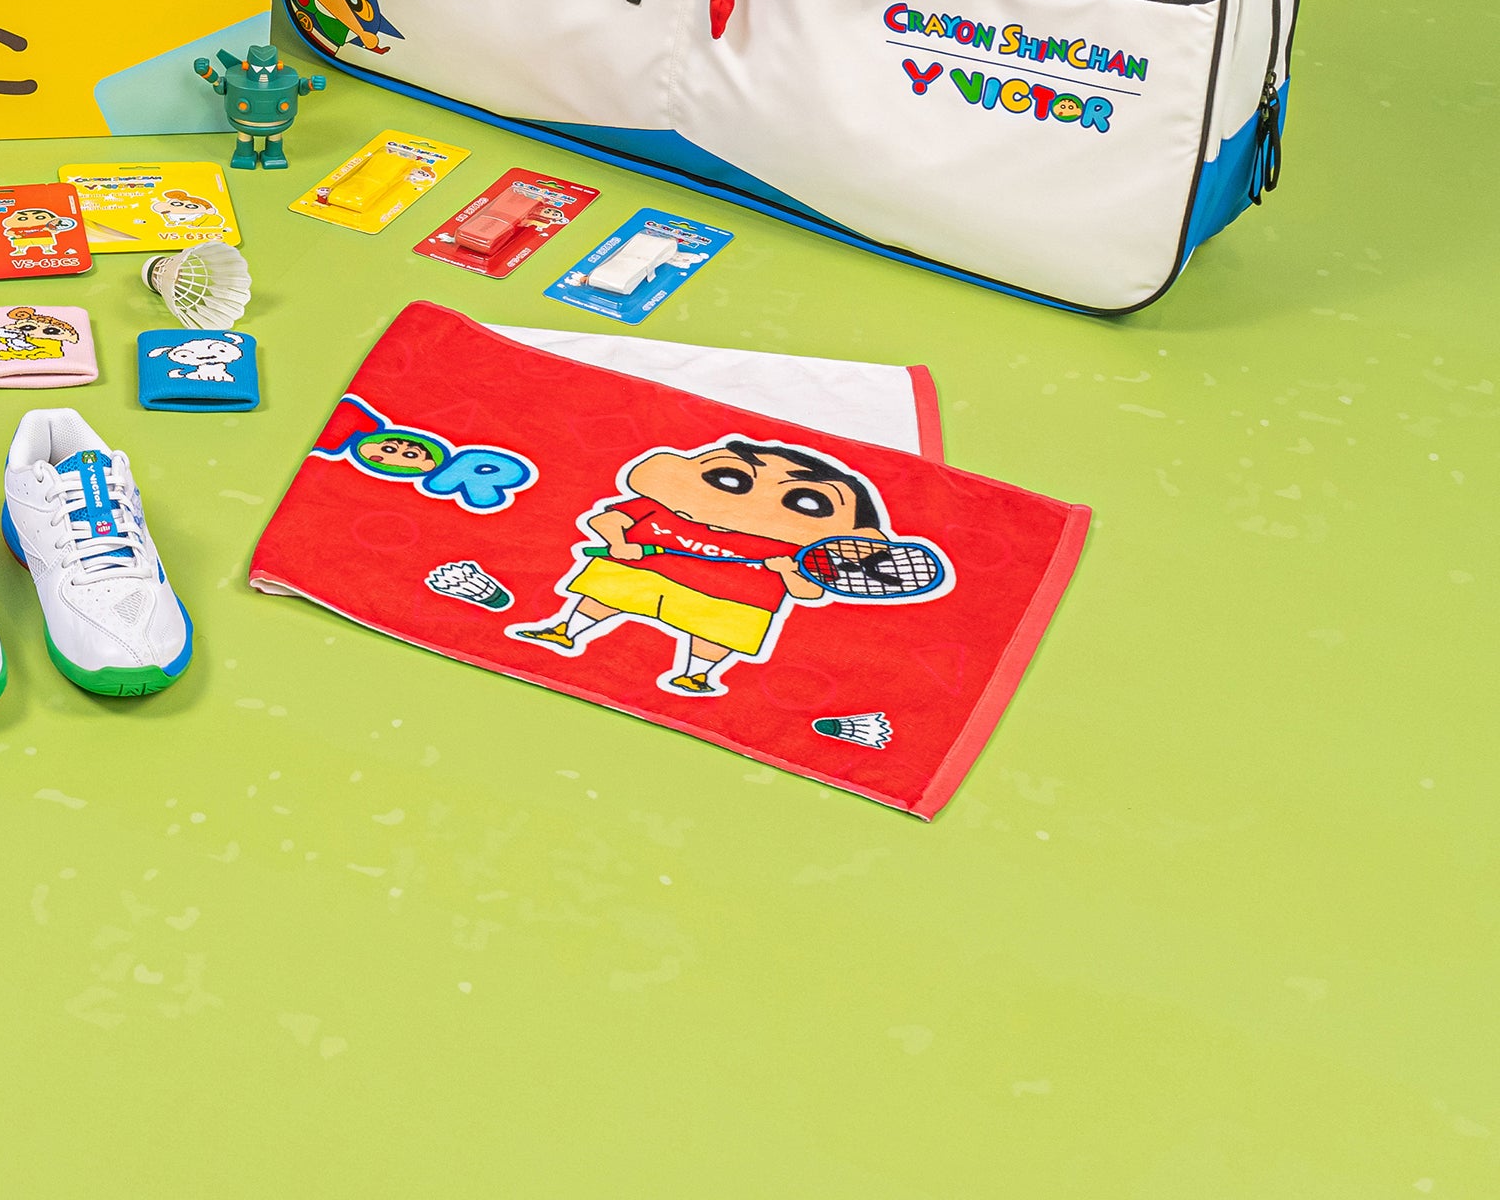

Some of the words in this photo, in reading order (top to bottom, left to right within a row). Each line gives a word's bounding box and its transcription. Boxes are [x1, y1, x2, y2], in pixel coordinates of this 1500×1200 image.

[883, 2, 997, 52] CRAYON
[998, 23, 1149, 82] SHINCHAN
[949, 67, 1114, 133] VICTOR
[158, 232, 225, 241] VS-63CS
[12, 258, 81, 269] VS-63CS
[90, 473, 103, 508] VICTOR
